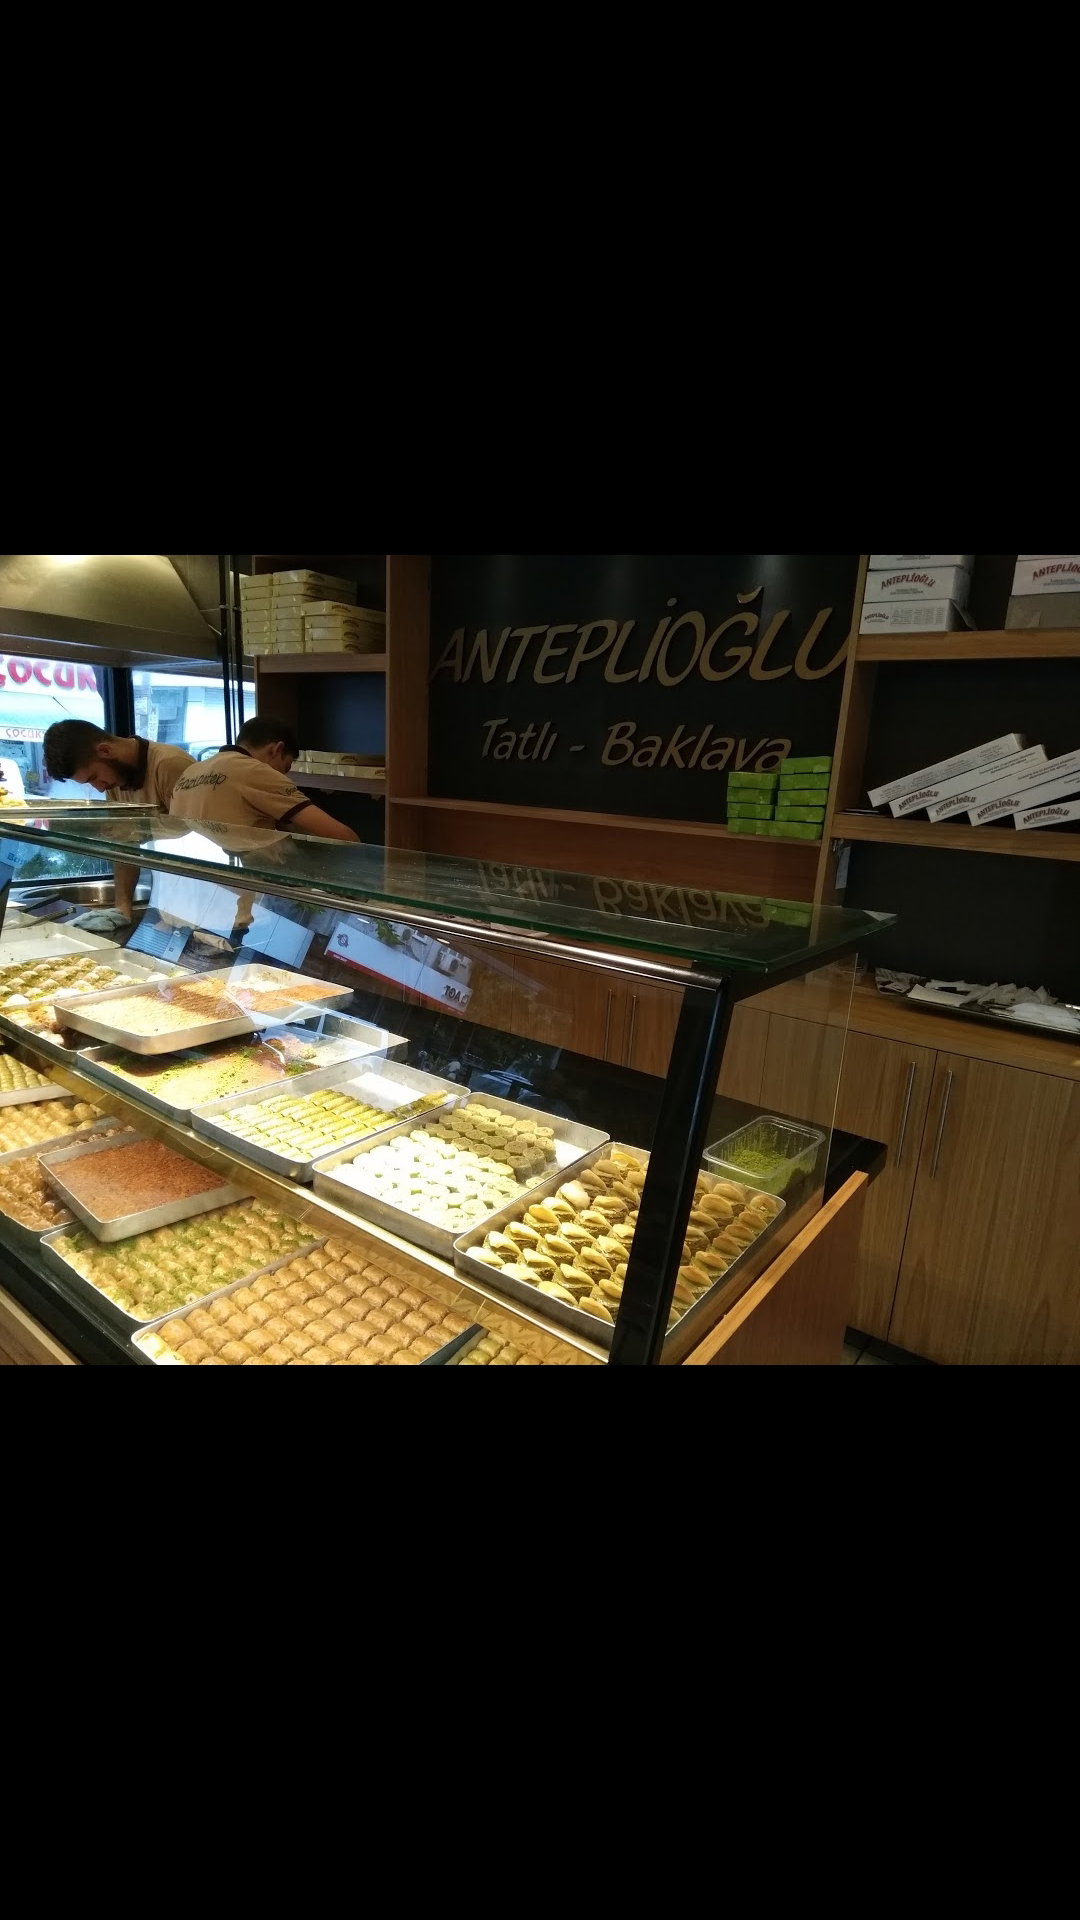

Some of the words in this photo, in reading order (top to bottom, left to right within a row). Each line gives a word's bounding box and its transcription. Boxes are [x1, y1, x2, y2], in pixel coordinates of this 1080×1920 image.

[881, 572, 936, 590] ANTEPLİOĞLU
[429, 585, 848, 687] ANTEPLİOĞLU
[0, 655, 98, 692] OCUK
[5, 728, 44, 739] ÇOCUK
[481, 718, 558, 761] Tatlı
[601, 720, 792, 773] Baklava
[898, 789, 940, 811] ANTEPLİOĞLU
[935, 795, 977, 816] ANTEPLİOĞLU
[976, 798, 1020, 820] ANTEPLİOĞLU
[1023, 807, 1070, 825] ANTEPLİOĞLU
